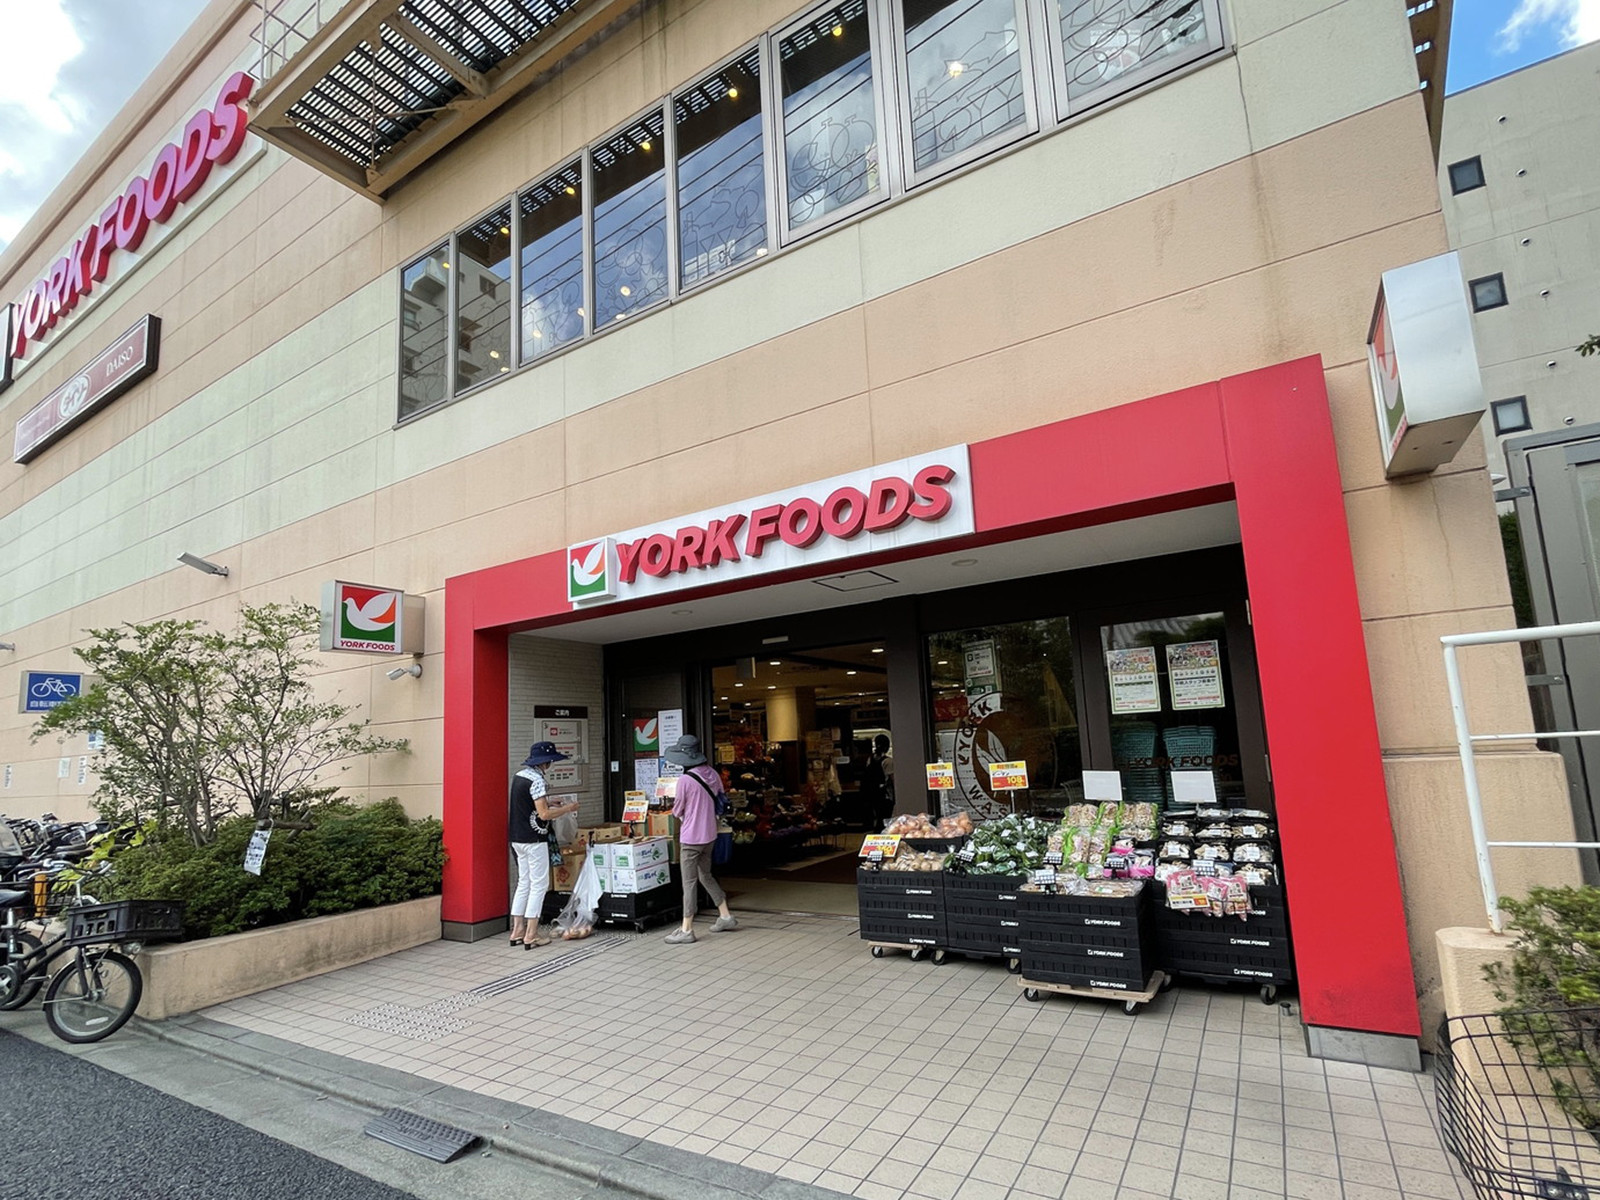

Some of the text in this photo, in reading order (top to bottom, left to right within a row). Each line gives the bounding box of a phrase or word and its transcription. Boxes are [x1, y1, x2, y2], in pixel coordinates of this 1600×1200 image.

[10, 71, 254, 359] YORK FOODS
[105, 346, 133, 377] DAISO
[616, 464, 957, 584] YORK FOODS
[340, 640, 395, 651] YORK FOODS
